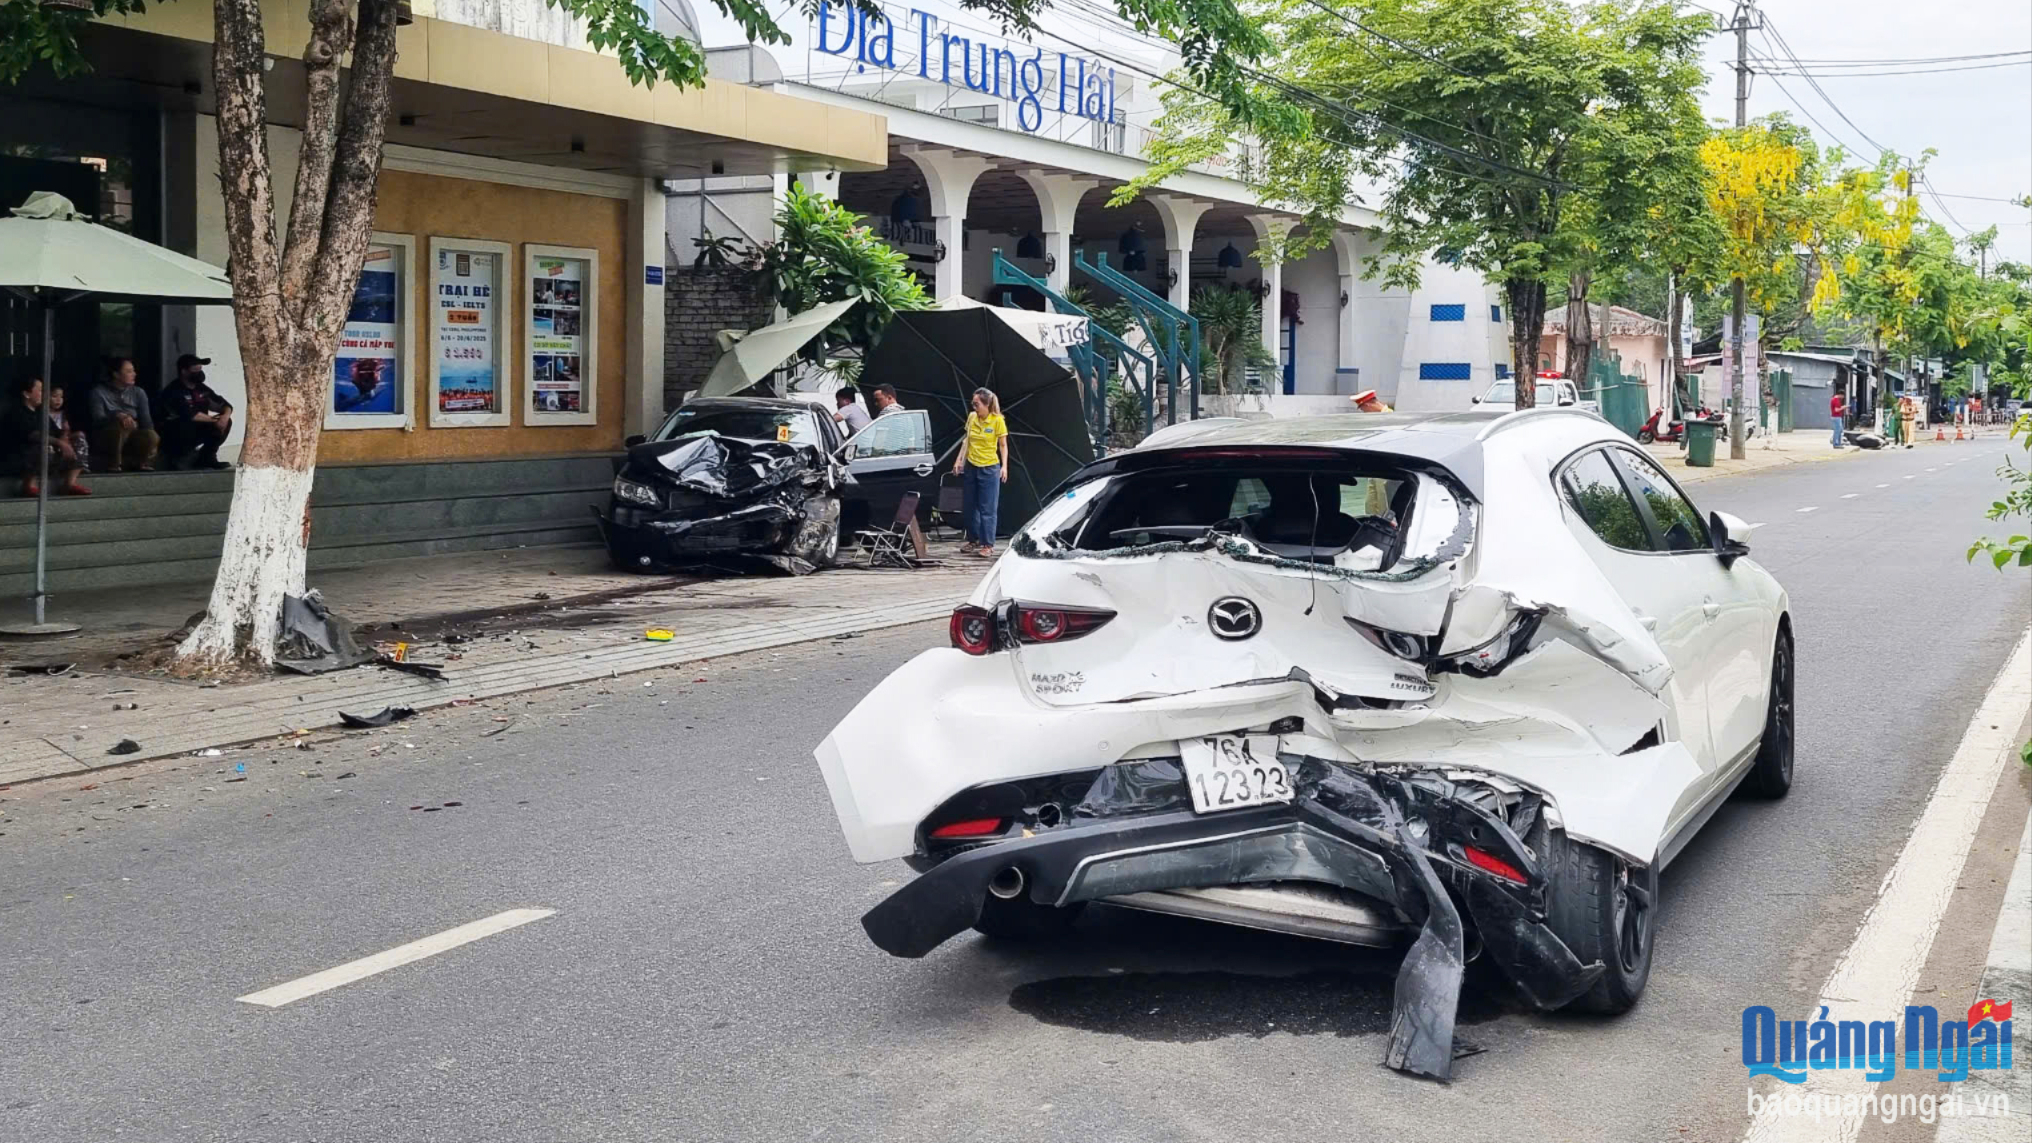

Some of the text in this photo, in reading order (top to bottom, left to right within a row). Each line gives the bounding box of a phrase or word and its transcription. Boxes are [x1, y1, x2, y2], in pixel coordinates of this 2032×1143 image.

[813, 0, 1116, 132] Địa Trung Hải
[463, 301, 485, 309] IELTS
[780, 429, 787, 438] 4
[1035, 684, 1082, 694] SPORT
[1390, 682, 1437, 694] LUXURY
[1203, 738, 1260, 768] 76A
